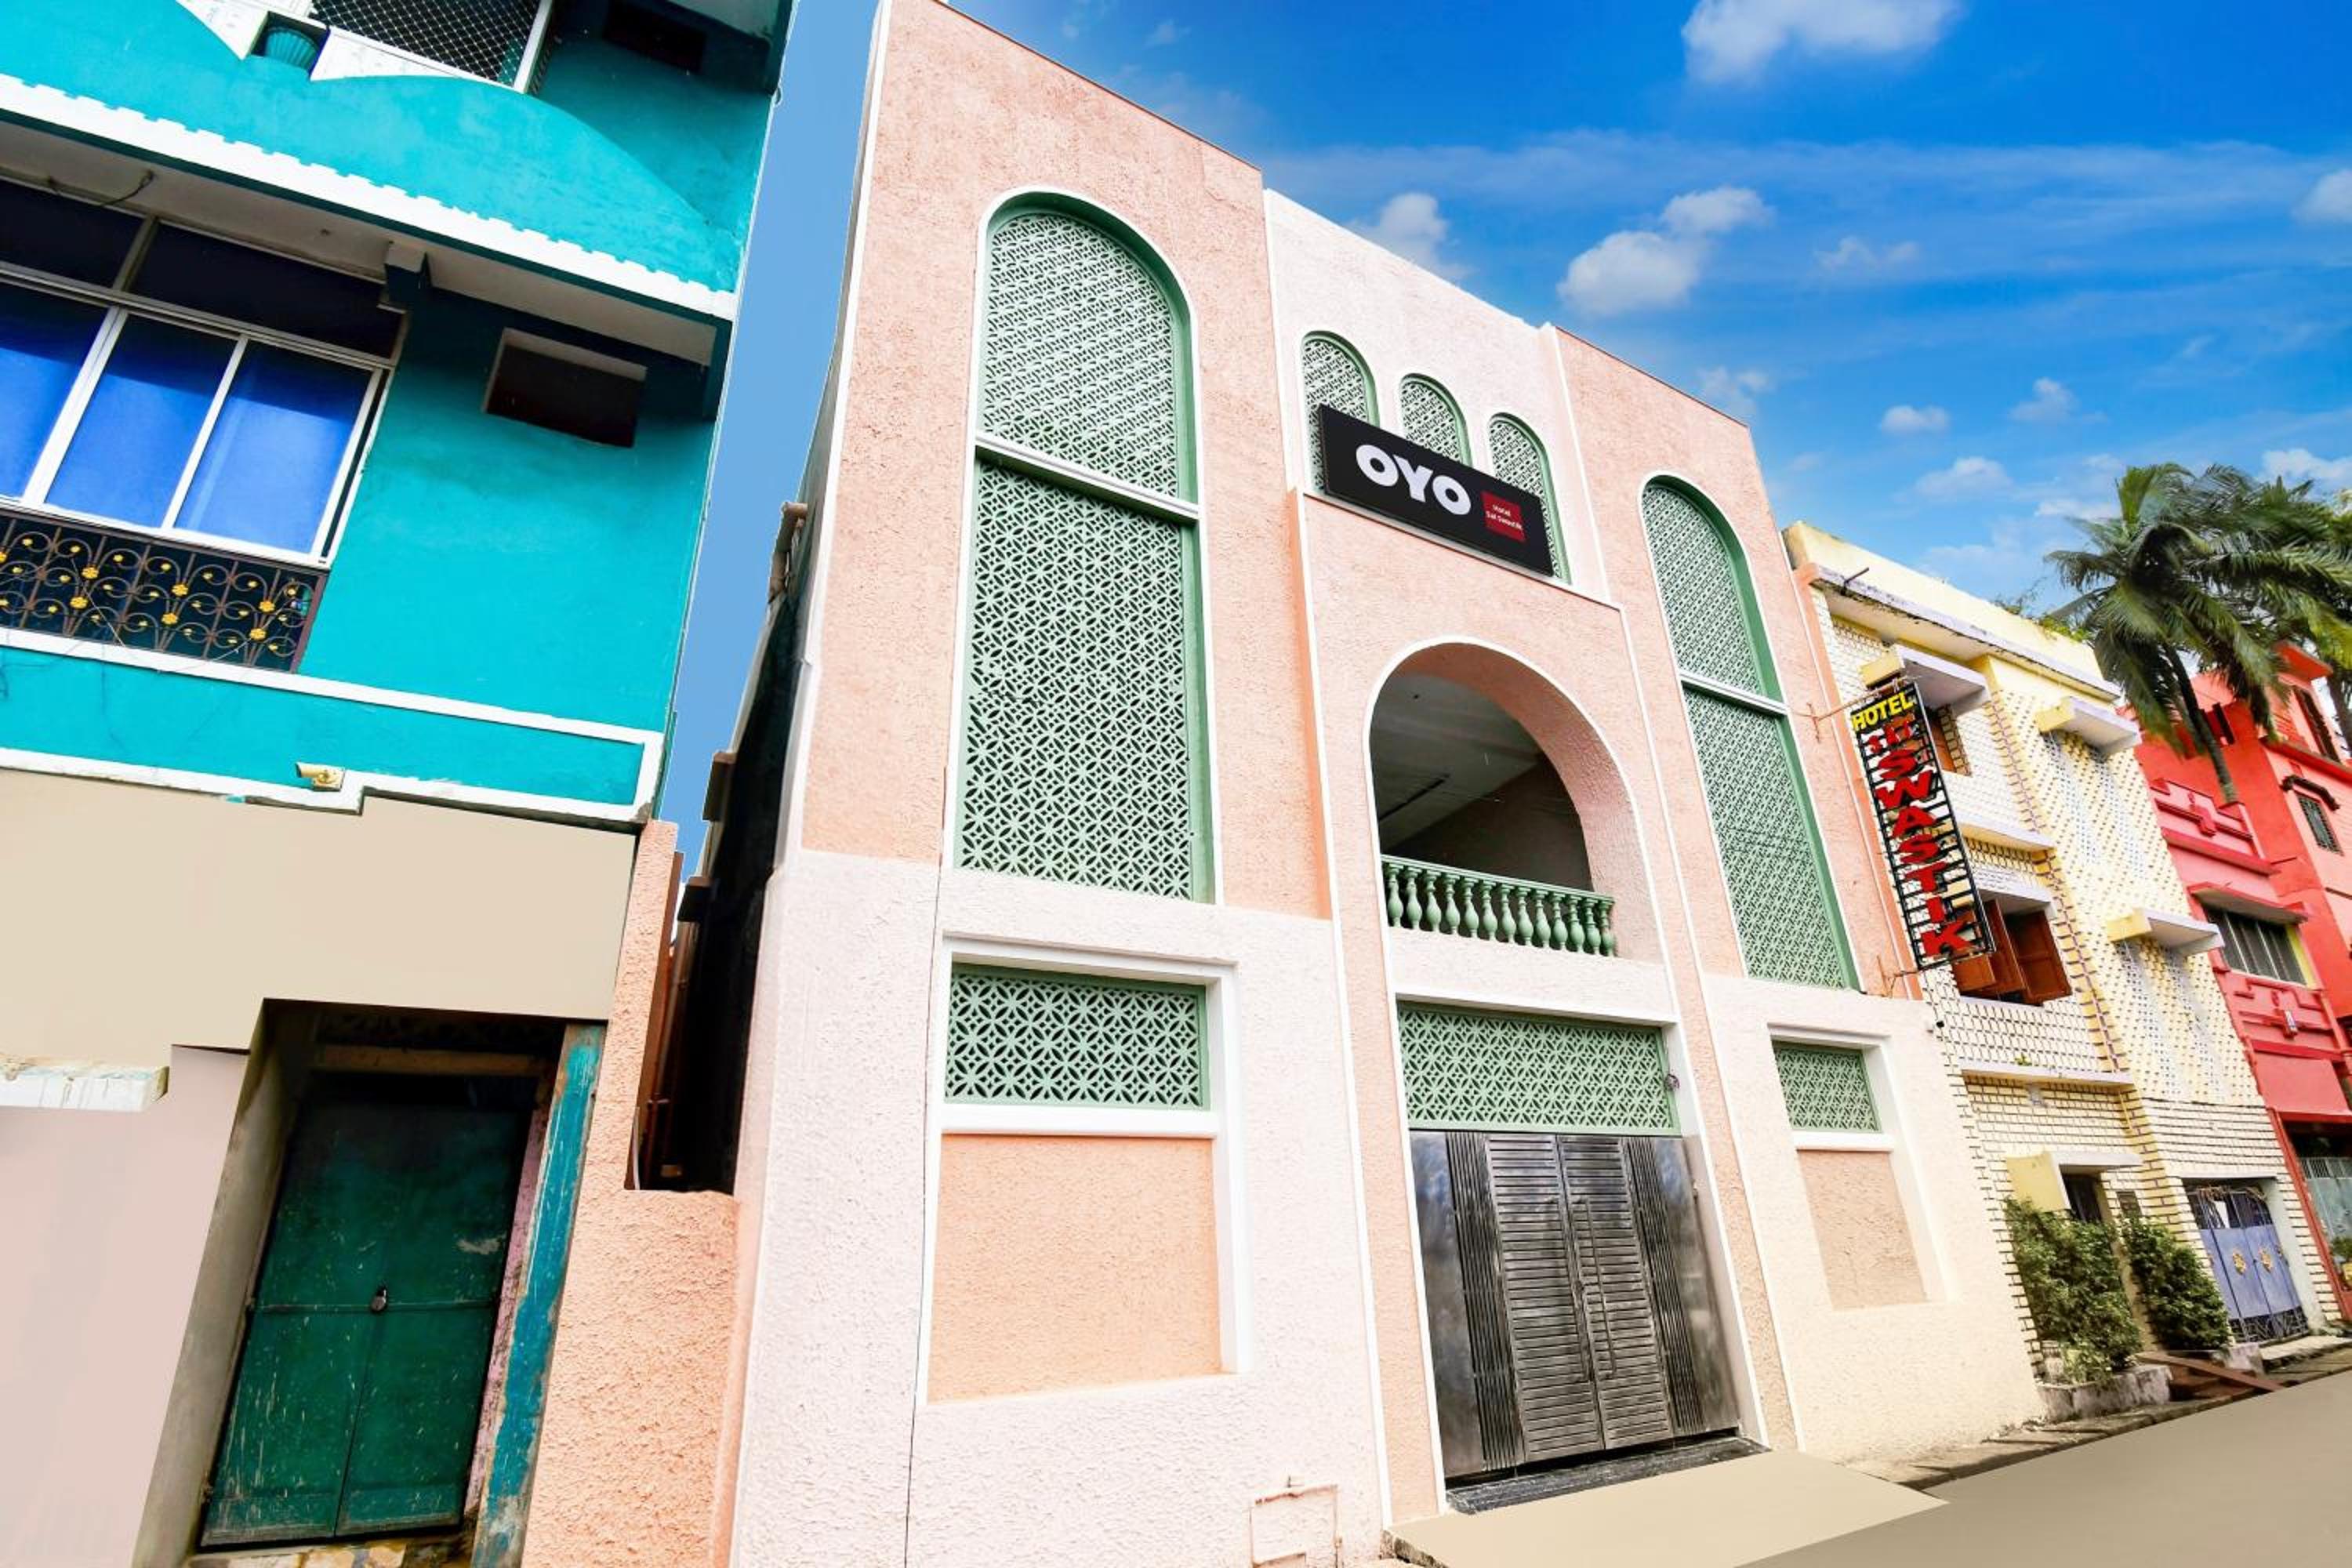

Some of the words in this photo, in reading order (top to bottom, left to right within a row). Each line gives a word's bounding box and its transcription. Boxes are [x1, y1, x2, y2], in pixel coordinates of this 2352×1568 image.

[1356, 445, 1471, 515] OYO
[1852, 691, 1914, 731] HOTEL
[1875, 749, 1973, 958] SWASTIK
